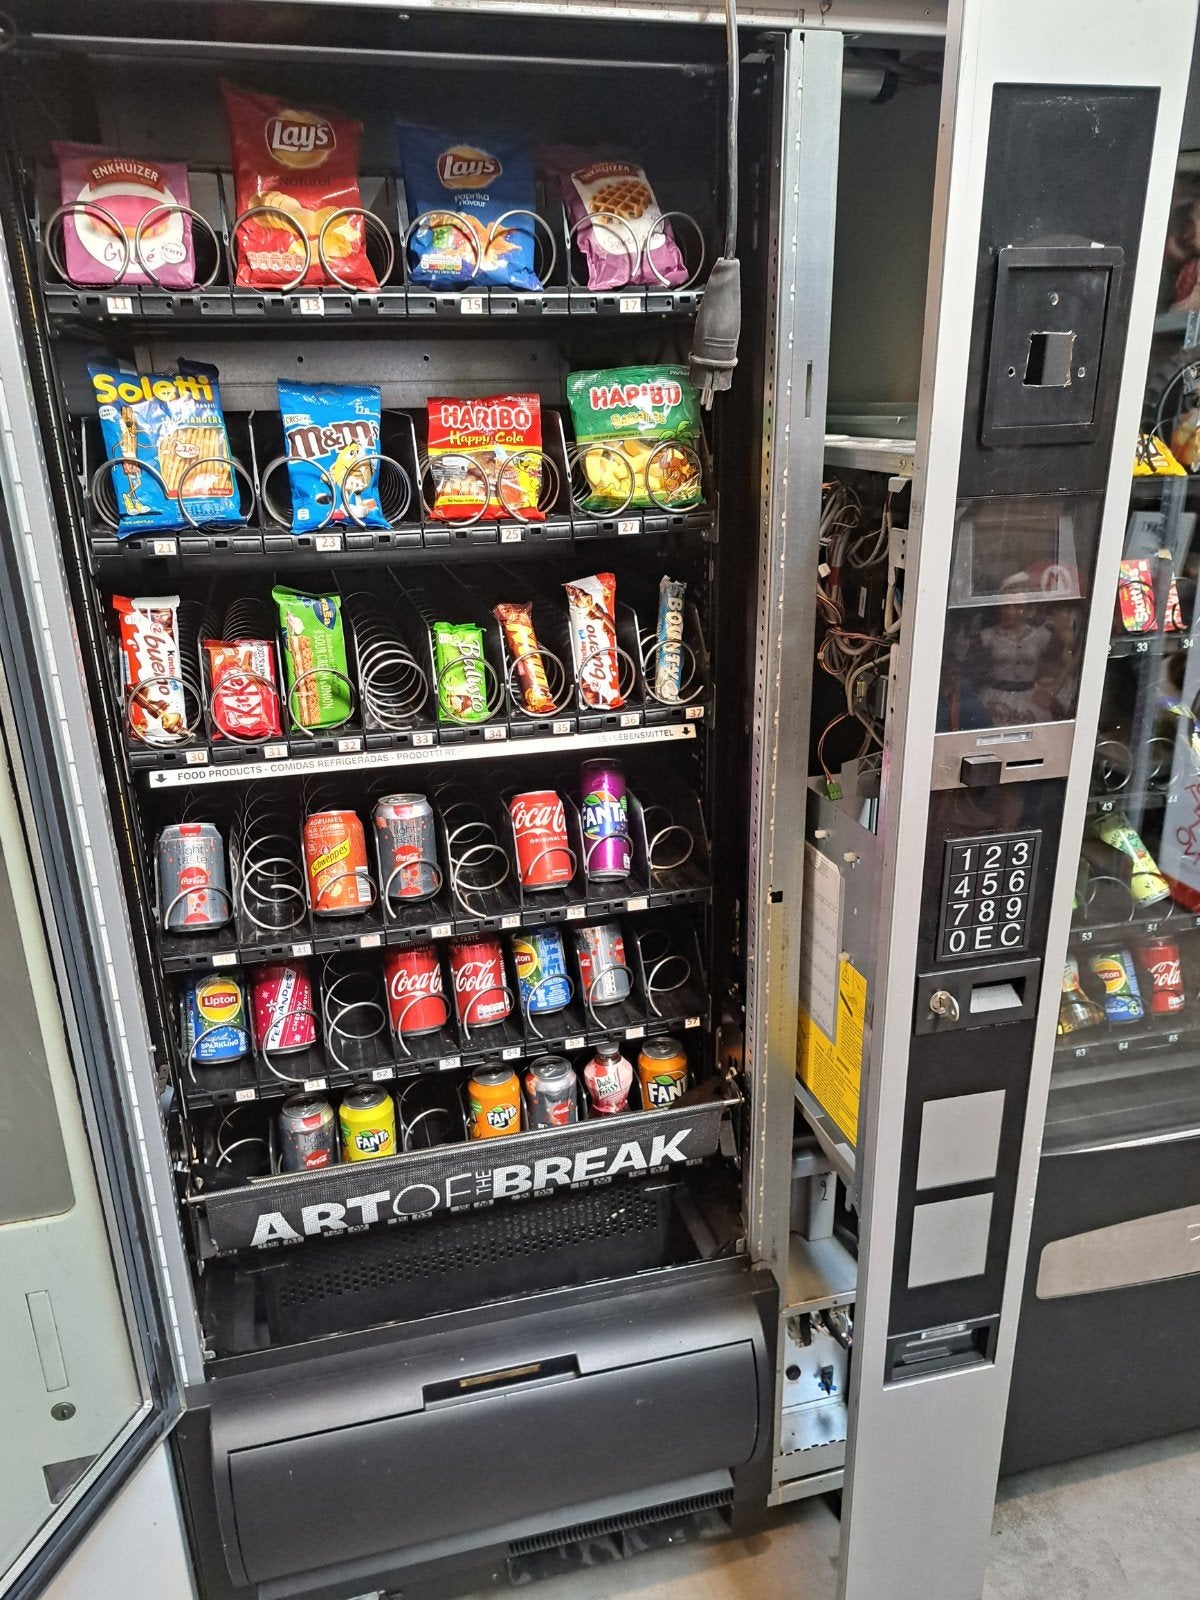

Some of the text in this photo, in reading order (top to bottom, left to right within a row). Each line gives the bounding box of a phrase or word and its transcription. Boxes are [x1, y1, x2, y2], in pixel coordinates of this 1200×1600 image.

[271, 120, 330, 152] Lay's
[92, 162, 159, 182] ENKHUIZER
[454, 193, 490, 203] paprika
[111, 298, 129, 310] 11
[304, 300, 321, 312] 13
[467, 299, 482, 310] 15
[624, 300, 638, 311] 17
[93, 373, 214, 404] Soletti
[441, 405, 532, 430] HARIBO
[449, 430, 524, 445] Happy Cola
[621, 522, 635, 533] 27
[505, 530, 520, 540] 25
[158, 543, 174, 554] 21
[322, 537, 336, 549] 23
[662, 597, 683, 681] BOUNTY
[1182, 639, 1195, 650] 34
[1136, 641, 1149, 653] 33
[458, 640, 485, 714] Balisto
[690, 708, 702, 718] 37
[624, 717, 636, 725] 36
[489, 728, 502, 738] 34
[556, 723, 568, 732] 35
[415, 735, 429, 744] 33
[613, 729, 674, 742] LEBENSMITTEL
[343, 741, 357, 750] 32
[190, 752, 205, 762] 30
[268, 747, 283, 757] 31
[177, 771, 206, 781] FOOD
[209, 766, 262, 778] PRODUCTS
[270, 760, 314, 772] COMIDAS
[317, 754, 389, 768] REFRIGERADAS
[1101, 802, 1114, 812] 43
[309, 816, 344, 827] AGRUMES
[312, 844, 349, 872] Schweppes
[961, 842, 1029, 871] 1 2 3
[953, 868, 1026, 899] 4 5 6
[570, 908, 582, 916] 45
[952, 896, 1022, 926] 7 8 9
[504, 917, 517, 926] 44
[435, 927, 449, 935] 43
[974, 926, 993, 950] E
[1000, 922, 1021, 946] C
[1081, 932, 1093, 941] 53
[203, 994, 236, 1007] Lipton
[687, 1018, 697, 1026] 57
[200, 1038, 239, 1050] SPARKLING
[1119, 1042, 1129, 1051] 64
[507, 1049, 519, 1057] 54
[444, 1058, 457, 1067] 53
[376, 1070, 389, 1079] 52
[239, 1090, 253, 1099] 50
[249, 1127, 695, 1247] ART OF THE BREAK
